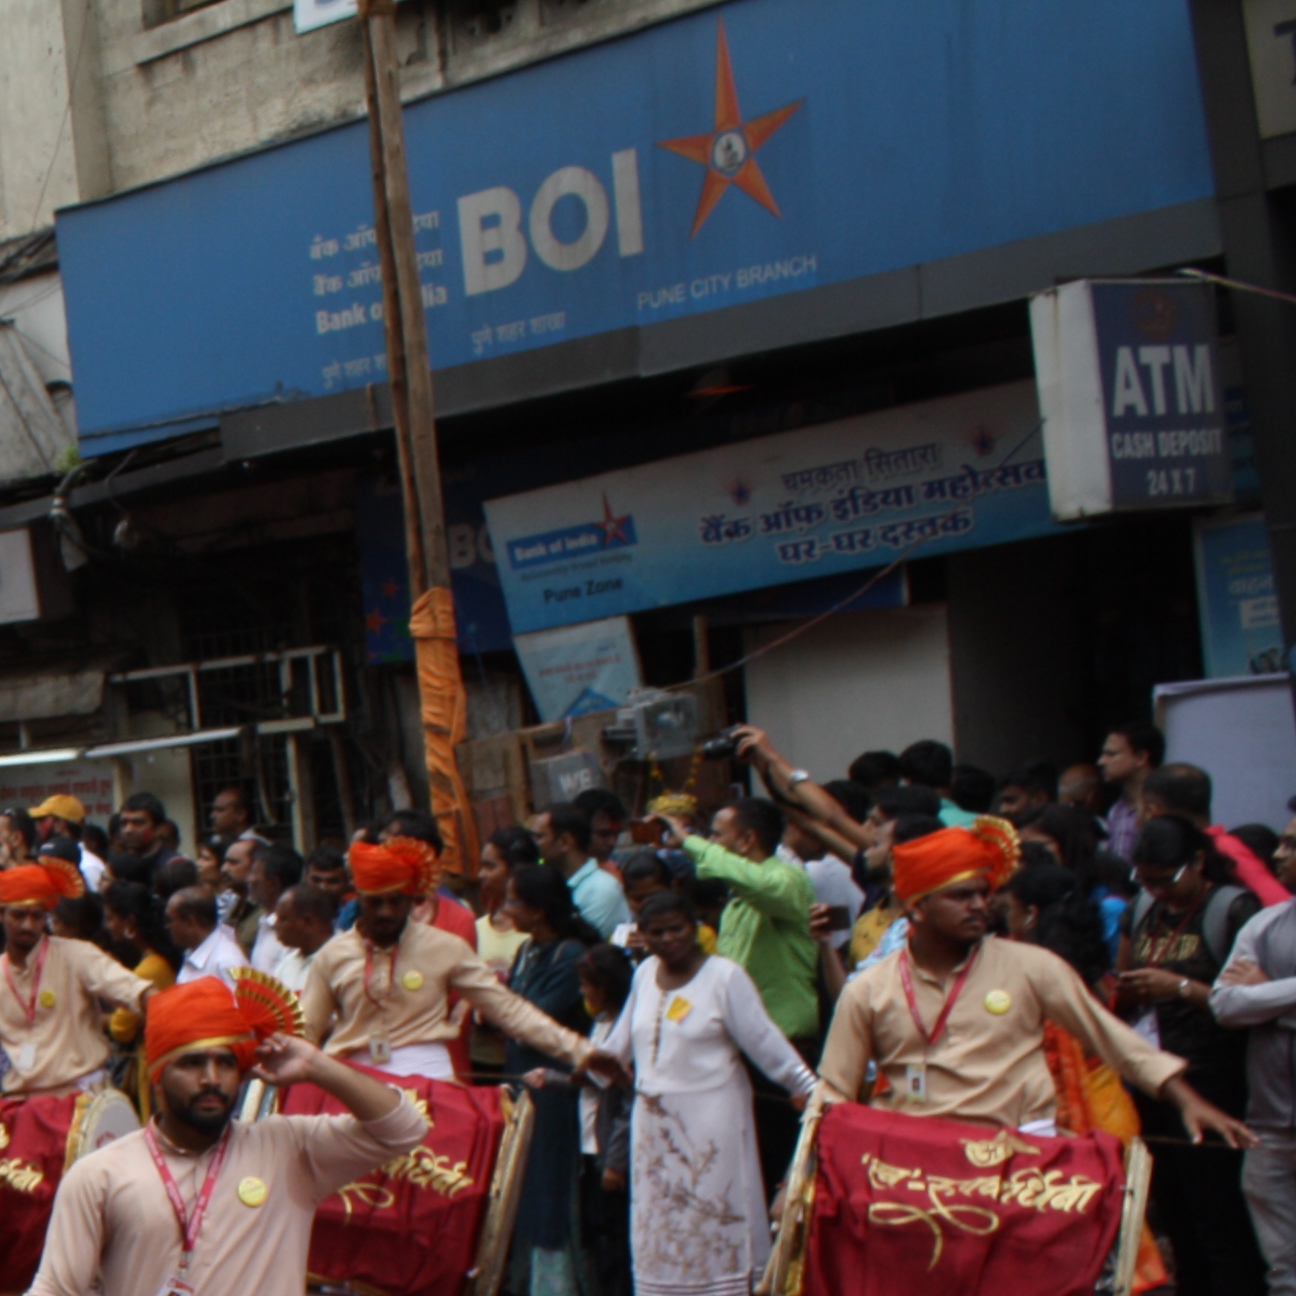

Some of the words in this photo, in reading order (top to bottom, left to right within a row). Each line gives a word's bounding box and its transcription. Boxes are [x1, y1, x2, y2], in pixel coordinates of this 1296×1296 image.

[458, 148, 644, 296] BOI
[637, 285, 687, 311] PUNE
[690, 273, 733, 297] CITY
[736, 254, 818, 288] BRANCH
[317, 303, 366, 334] Bank
[1113, 344, 1215, 417] ATM
[1112, 431, 1155, 459] CASH
[1158, 428, 1222, 458] DEPOSIT
[781, 457, 860, 493] चमकता
[864, 443, 939, 480] सितारा
[1147, 469, 1168, 496] 24
[1171, 469, 1185, 494] X
[1185, 468, 1197, 493] 7
[701, 511, 752, 545] बैंक
[833, 485, 915, 522] इंडिया
[880, 508, 975, 547] दस्तक
[515, 542, 548, 562] Bank
[549, 538, 563, 554] of
[564, 532, 600, 551] India
[543, 586, 582, 605] Pune
[584, 577, 625, 597] Zone
